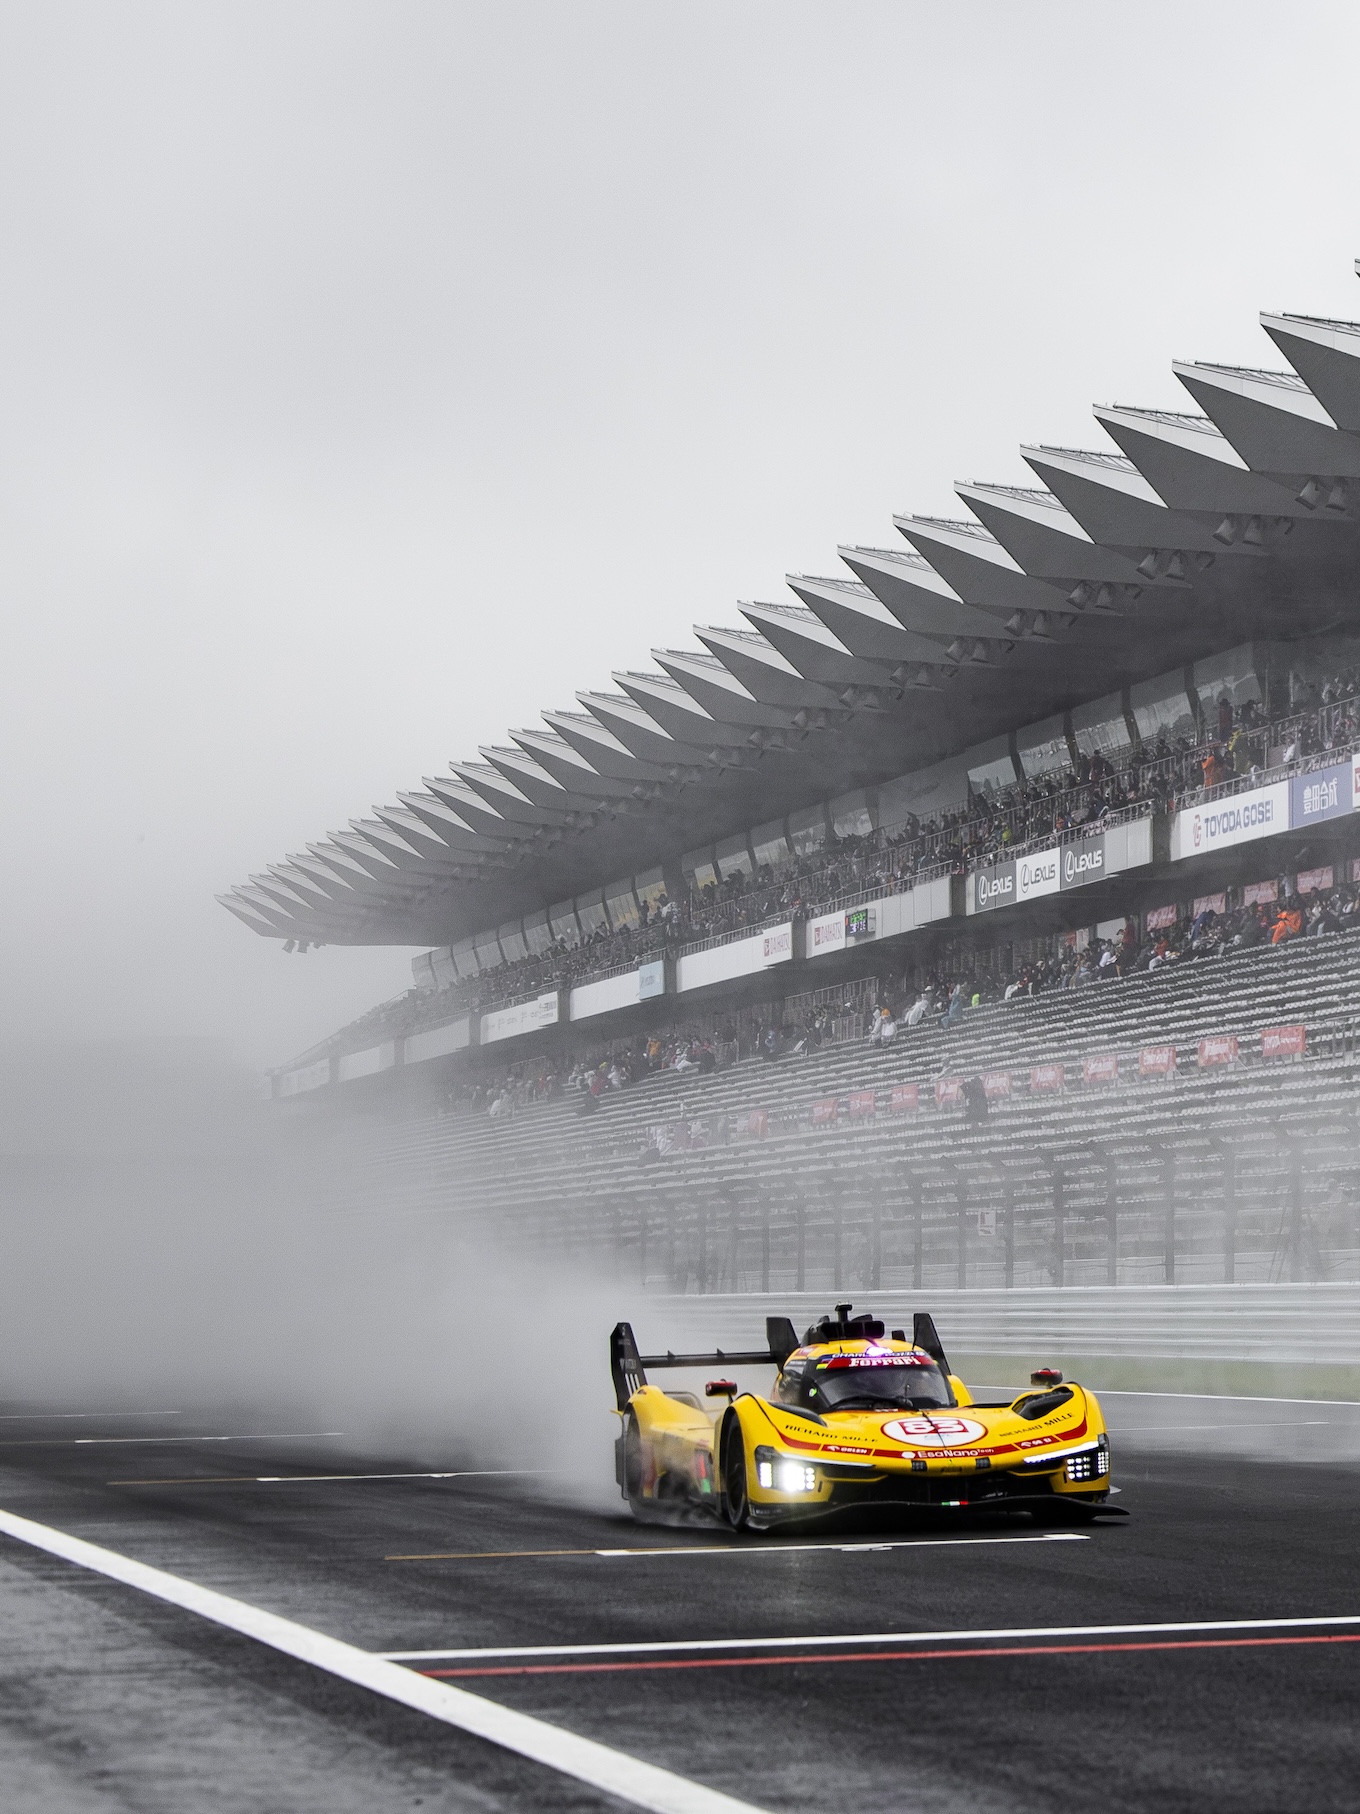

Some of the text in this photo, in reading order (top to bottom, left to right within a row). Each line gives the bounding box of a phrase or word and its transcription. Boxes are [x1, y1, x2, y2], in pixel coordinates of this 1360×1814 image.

[1204, 800, 1274, 838] TOYODA GOSEI
[1075, 850, 1103, 873] LEXUS
[1030, 864, 1056, 885] LEXUS
[987, 876, 1013, 898] LEXUS
[849, 1356, 922, 1368] Ferrari
[901, 1420, 967, 1434] 83
